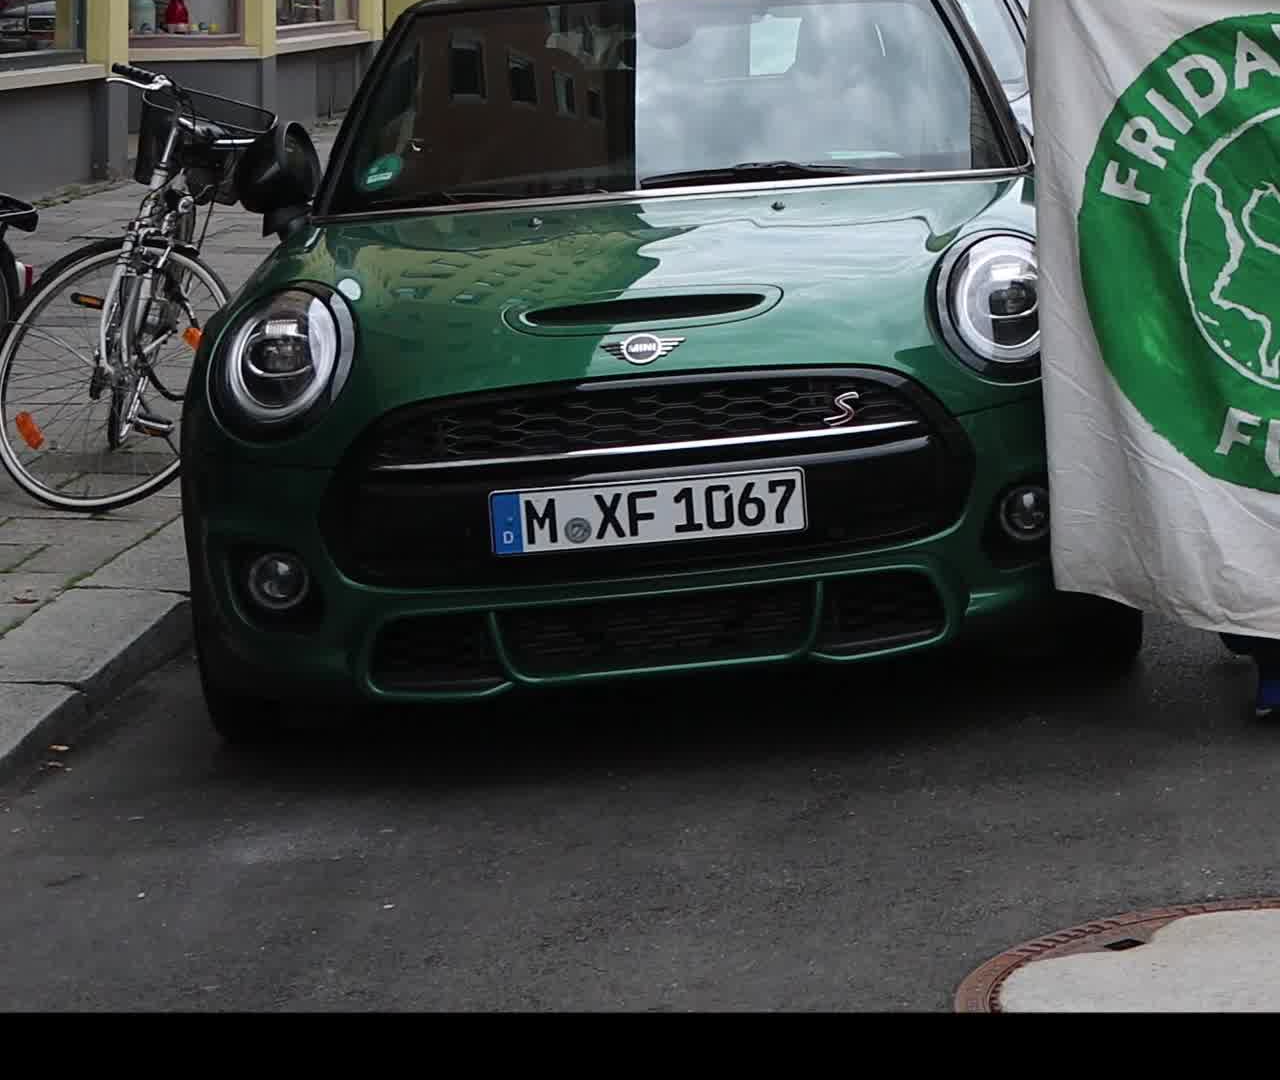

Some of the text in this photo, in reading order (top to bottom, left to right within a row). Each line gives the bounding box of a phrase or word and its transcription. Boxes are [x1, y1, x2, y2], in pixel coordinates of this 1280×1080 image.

[627, 343, 657, 353] MINI
[523, 478, 797, 545] M XF 1067
